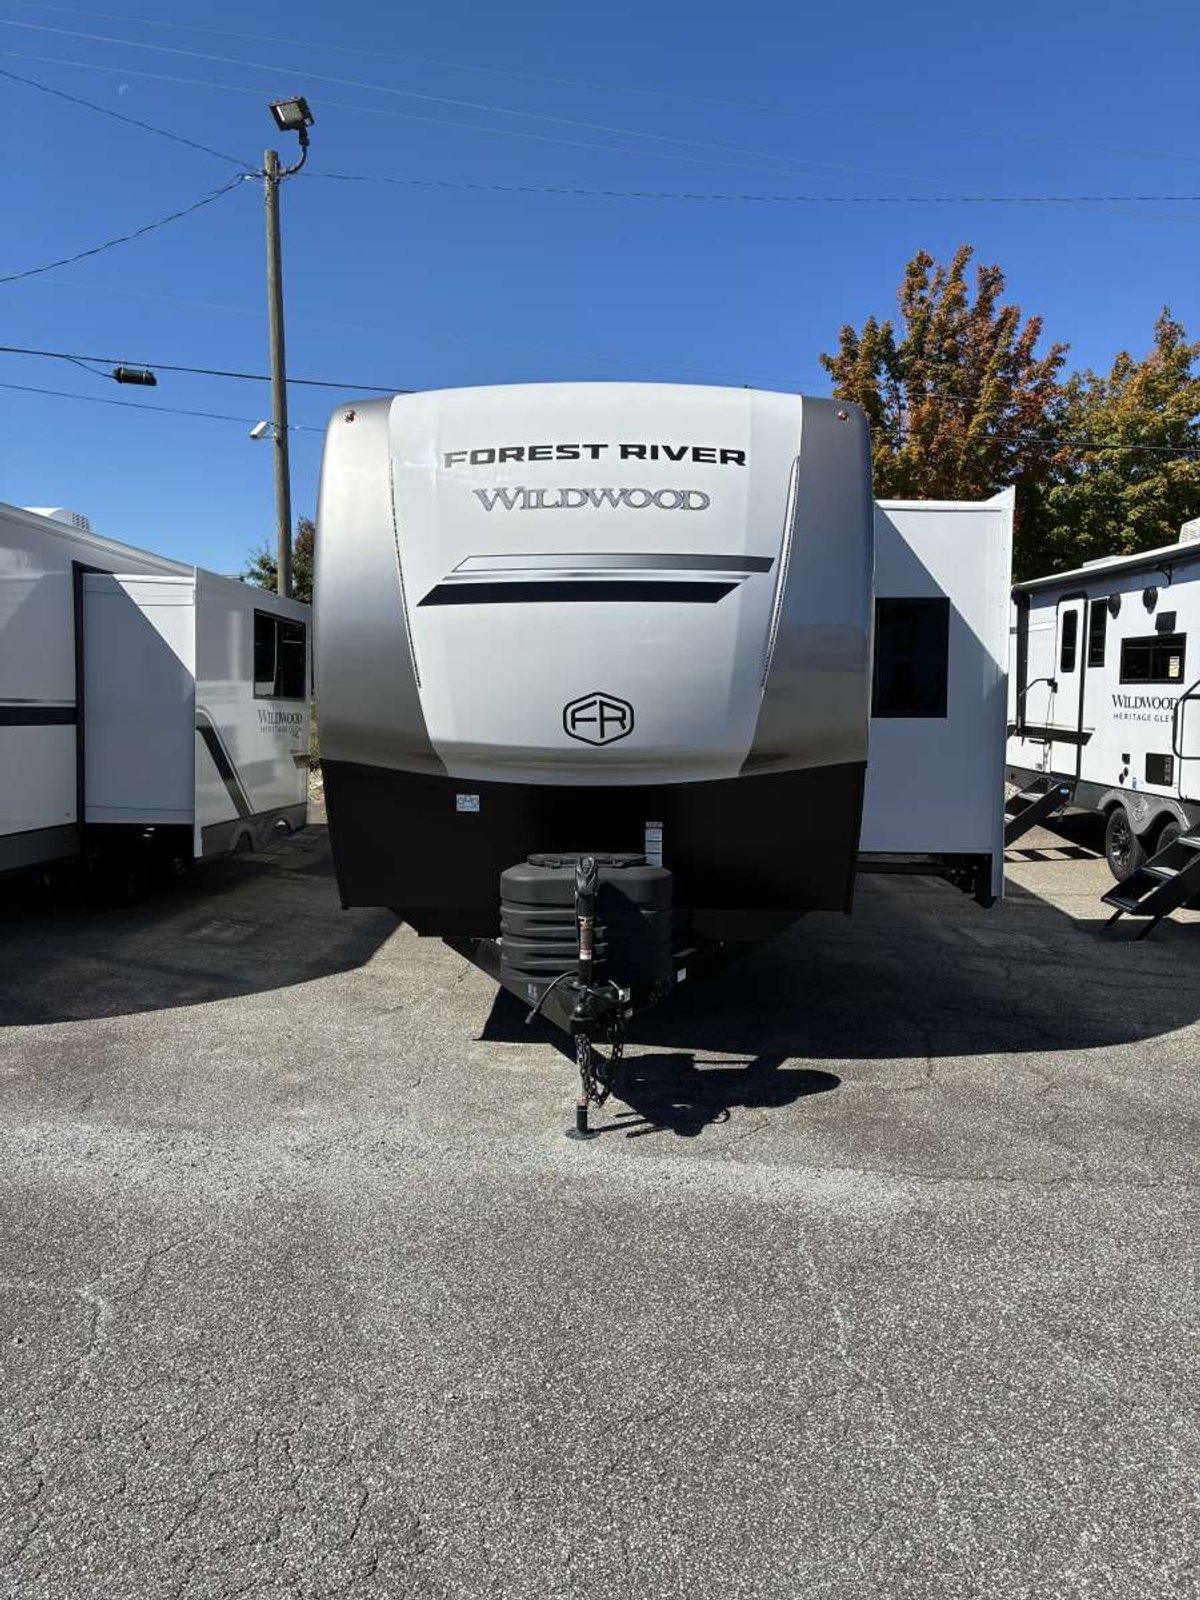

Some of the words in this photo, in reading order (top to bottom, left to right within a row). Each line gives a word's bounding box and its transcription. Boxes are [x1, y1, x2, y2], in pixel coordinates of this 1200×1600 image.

[443, 444, 608, 468] FOREST
[619, 444, 747, 466] RIVER
[472, 486, 711, 512] WILDWOOD
[1113, 712, 1152, 721] HERITAGE
